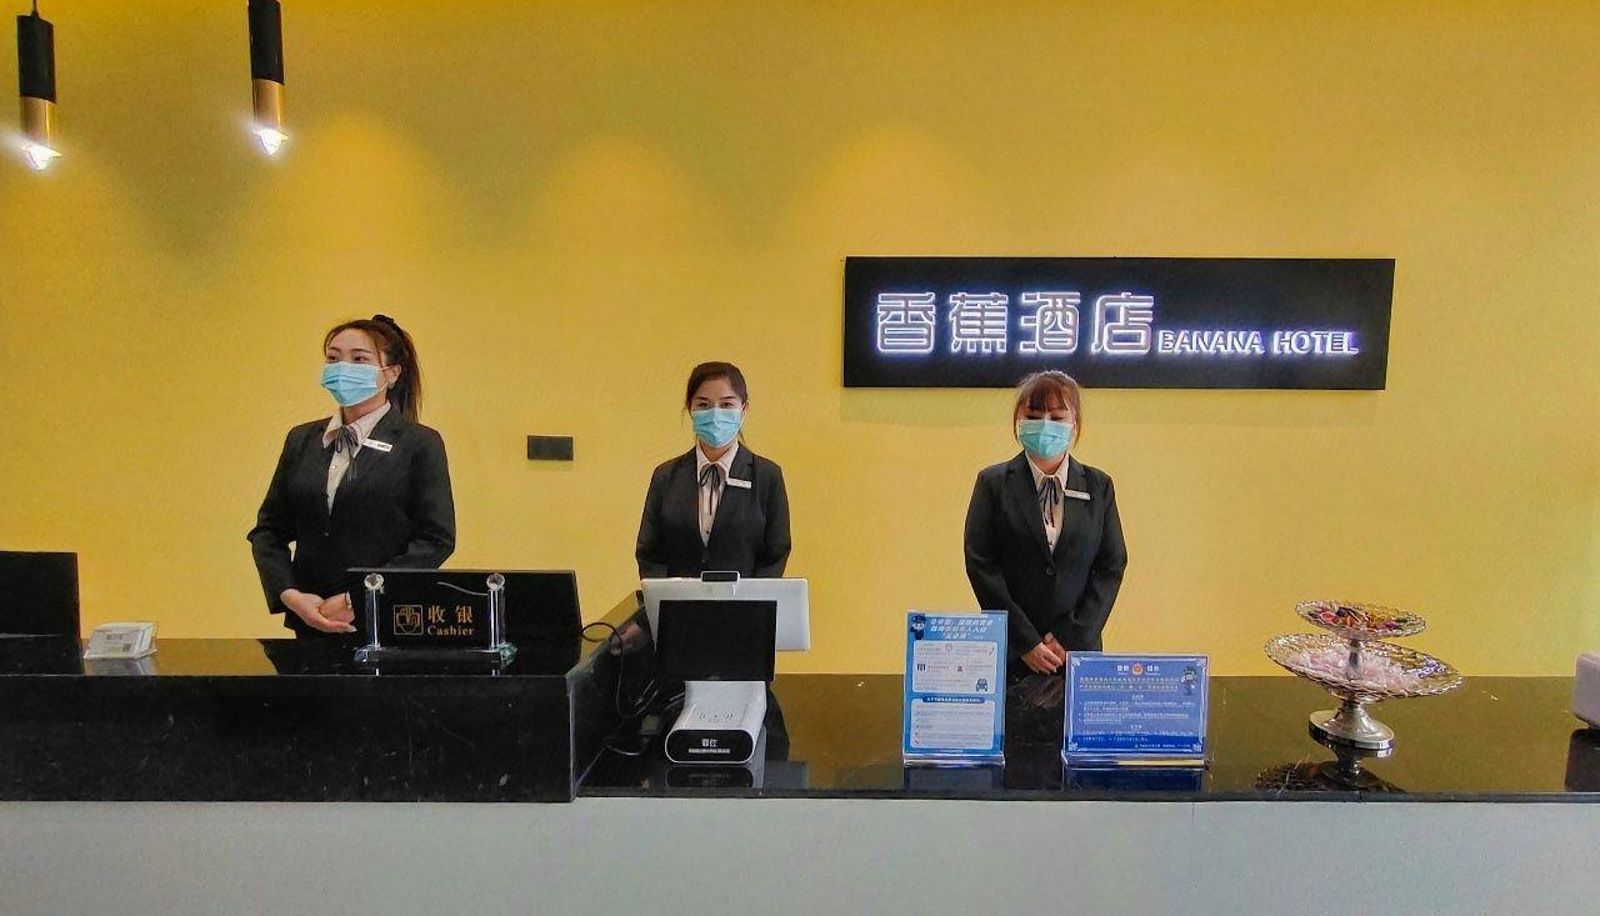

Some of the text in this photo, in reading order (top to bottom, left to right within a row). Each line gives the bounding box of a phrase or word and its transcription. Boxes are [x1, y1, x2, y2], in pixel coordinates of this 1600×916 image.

[876, 291, 1155, 356] 香蕉酒店
[1157, 330, 1360, 356] BANANA HOTEL
[427, 605, 473, 624] 收银
[427, 625, 475, 636] Cashier
